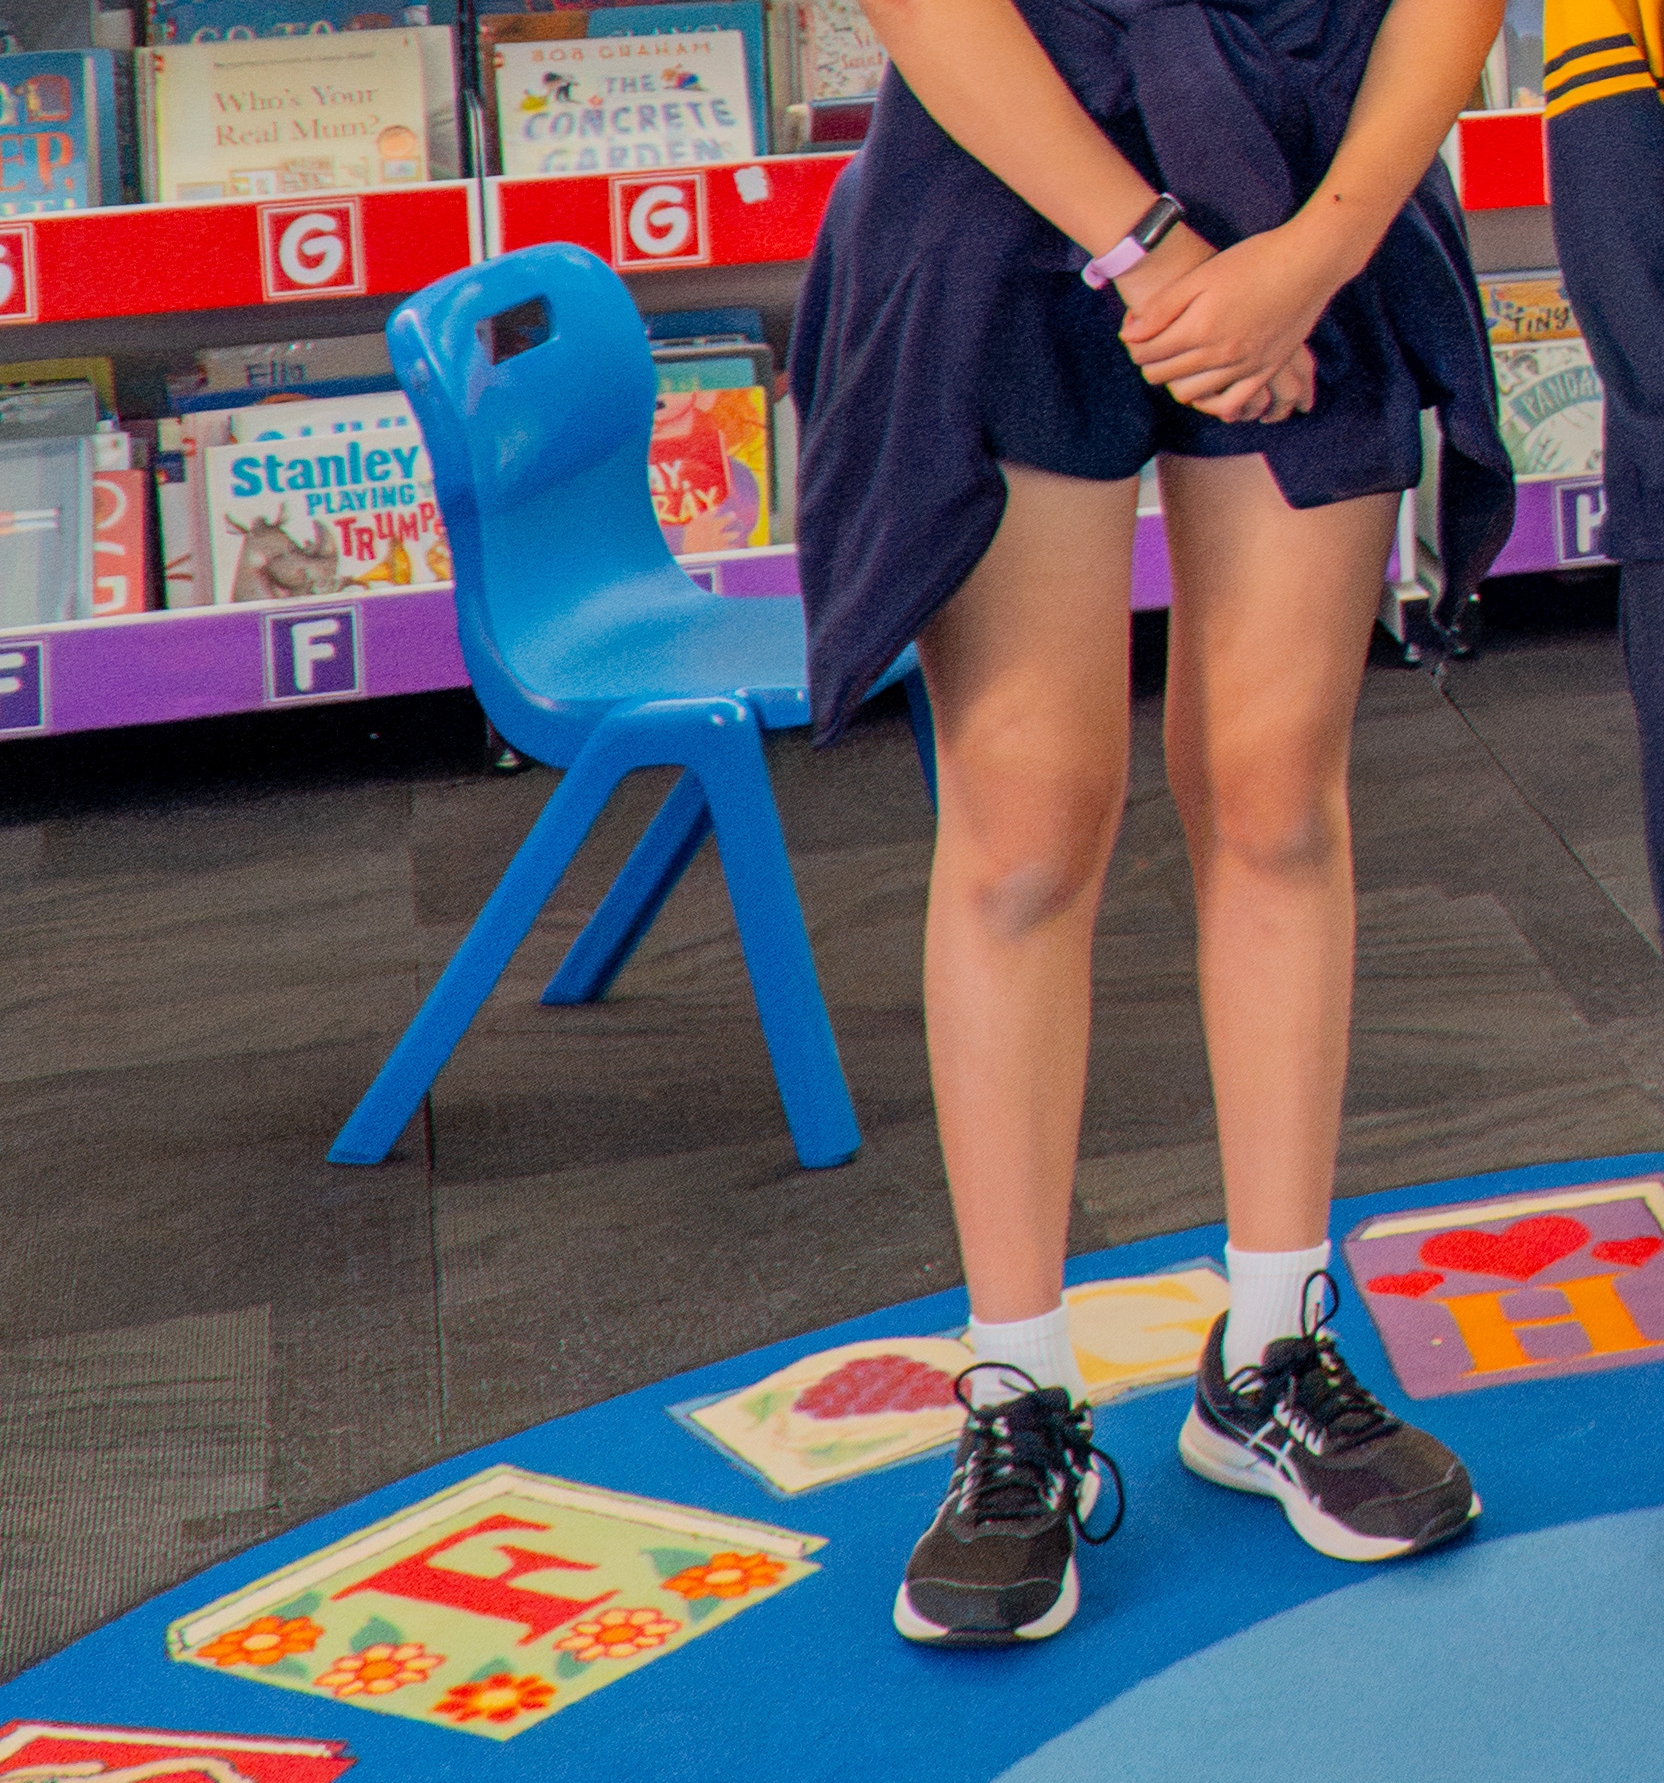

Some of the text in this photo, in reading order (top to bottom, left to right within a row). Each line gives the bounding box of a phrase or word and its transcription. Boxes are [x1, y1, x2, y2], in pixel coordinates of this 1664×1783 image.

[531, 41, 712, 63] BOB GRAHAM
[214, 84, 378, 114] Who's Your
[604, 74, 657, 95] THE
[214, 115, 383, 148] Real Mum?
[521, 97, 737, 144] CONCRETE
[540, 137, 725, 174] GARDEN
[629, 184, 689, 256] G
[279, 213, 344, 285] G
[1521, 367, 1603, 418] PANDA
[230, 441, 420, 499] Stanley
[305, 482, 418, 517] PLAYING
[291, 619, 339, 692] F
[330, 1513, 621, 1648] F
